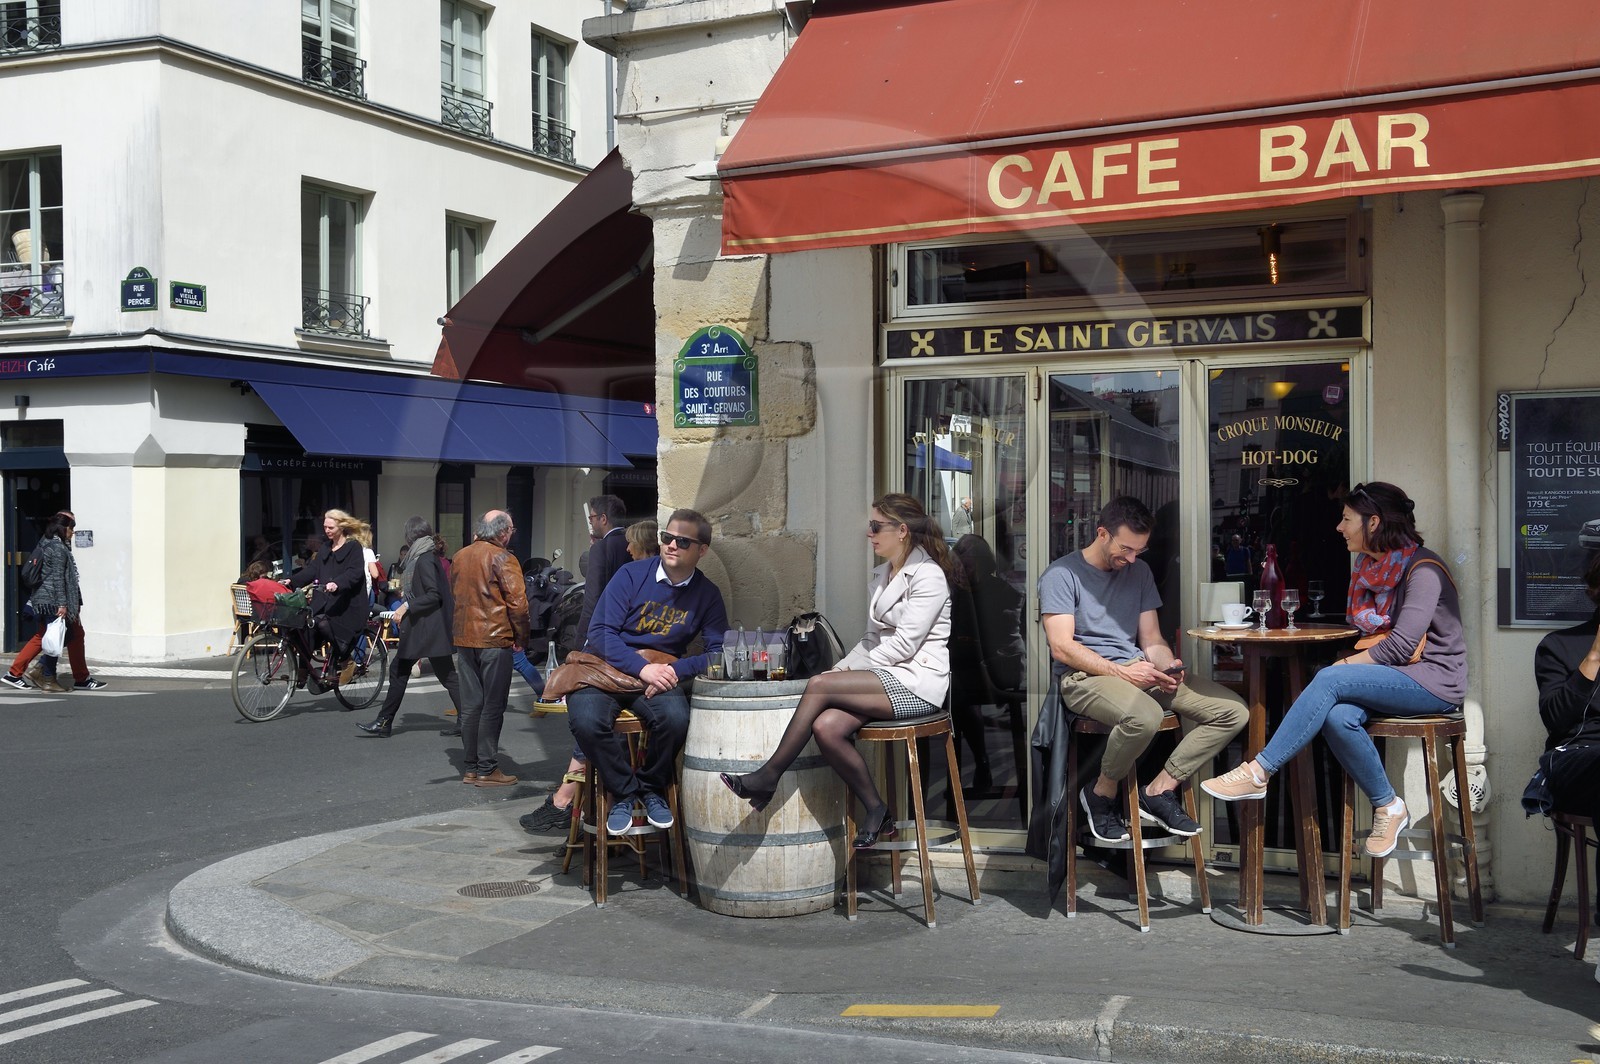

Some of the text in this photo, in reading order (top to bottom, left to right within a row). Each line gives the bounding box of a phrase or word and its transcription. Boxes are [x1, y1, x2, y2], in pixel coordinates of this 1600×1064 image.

[987, 112, 1430, 209] CAFE BAR
[127, 298, 151, 306] PERCHE
[183, 298, 202, 306] TEMPLE
[964, 313, 1277, 354] LE SAINT GERVAIS
[0, 358, 55, 373] EIZH Café
[706, 371, 723, 382] RUE
[684, 386, 746, 399] DES COUTURES
[685, 402, 746, 414] SAINT-GERVAIS
[1217, 415, 1343, 442] CROQUE MONSIEUR
[911, 426, 947, 449] PLAT
[1526, 442, 1563, 453] TOUT
[276, 458, 307, 467] CRÊPE
[1241, 450, 1318, 466] HOT-DOG
[1526, 455, 1563, 465] TOUT
[1526, 467, 1564, 478] TOUT
[1566, 467, 1585, 477] DE
[1527, 500, 1551, 508] 179 €
